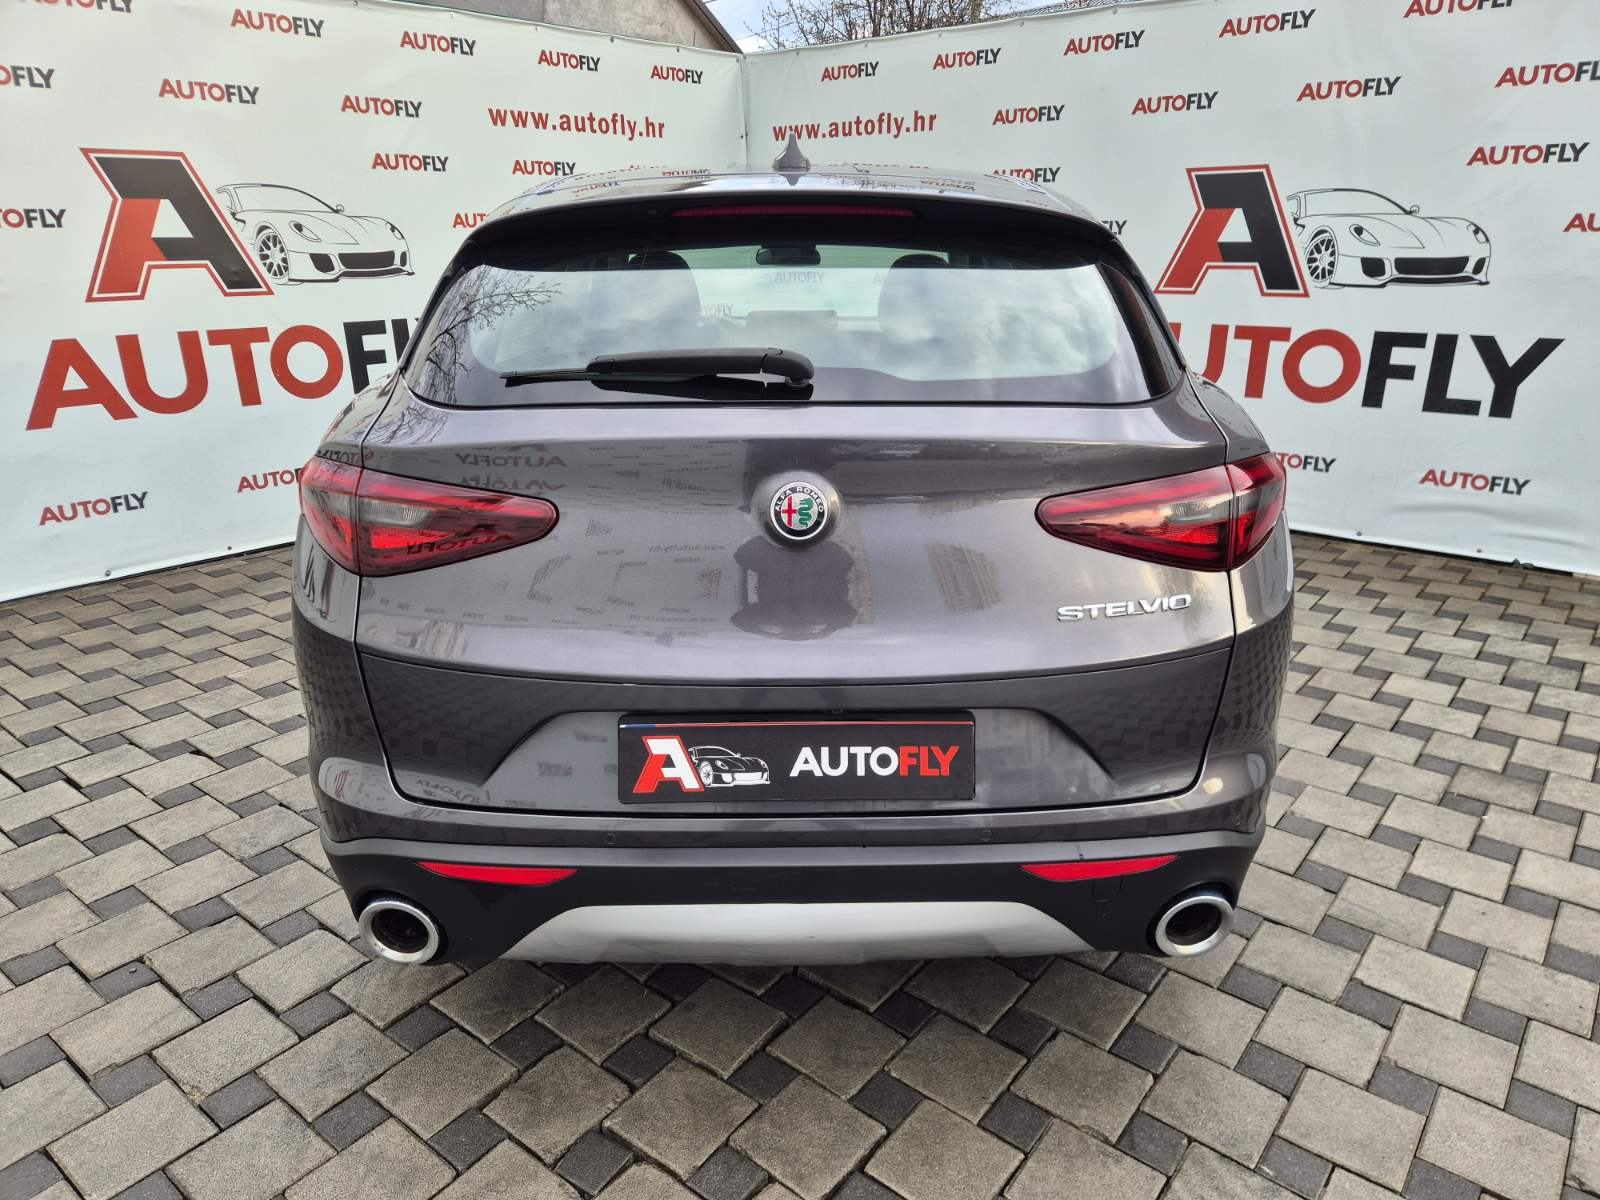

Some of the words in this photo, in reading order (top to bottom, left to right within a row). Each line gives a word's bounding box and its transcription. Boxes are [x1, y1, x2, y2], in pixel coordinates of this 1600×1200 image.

[231, 9, 324, 38] AUTOFLY
[1219, 9, 1316, 38] AUTOFLY
[400, 31, 476, 56] AUTOFLY
[1063, 30, 1145, 56] AUTOFLY
[538, 49, 600, 72] AUTOFLY
[821, 61, 879, 82] AUTOFLY
[933, 48, 1001, 70] AUTOFLY
[0, 65, 55, 89] OFLY
[651, 65, 703, 85] AUTOFLY
[1494, 60, 1600, 88] AUTOFL
[159, 78, 259, 104] AUTOFLY
[1297, 76, 1401, 102] AUTOFLY
[341, 95, 422, 118] AUTOFLY
[992, 104, 1065, 125] AUTOFLY
[1131, 91, 1219, 115] AUTOFLY
[488, 107, 665, 141] www.autofly.hr
[773, 110, 937, 142] www.autofly.hr
[372, 153, 448, 172] AUTOFLY
[1466, 142, 1590, 166] AUTOFLY
[512, 160, 576, 176] AUTOFLY
[0, 208, 66, 228] OFLY
[26, 318, 420, 431] AUTOF
[1167, 322, 1565, 418] TOFLY
[1273, 452, 1337, 472] TOFLY
[237, 467, 302, 493] AUTO
[1419, 469, 1531, 496] AUTOFLY
[39, 491, 148, 526] AUTOFLY
[775, 489, 793, 511] ALFA
[796, 486, 824, 513] ROMEO
[1057, 594, 1193, 622] STELVIO
[789, 745, 959, 777] AUTOFLY
